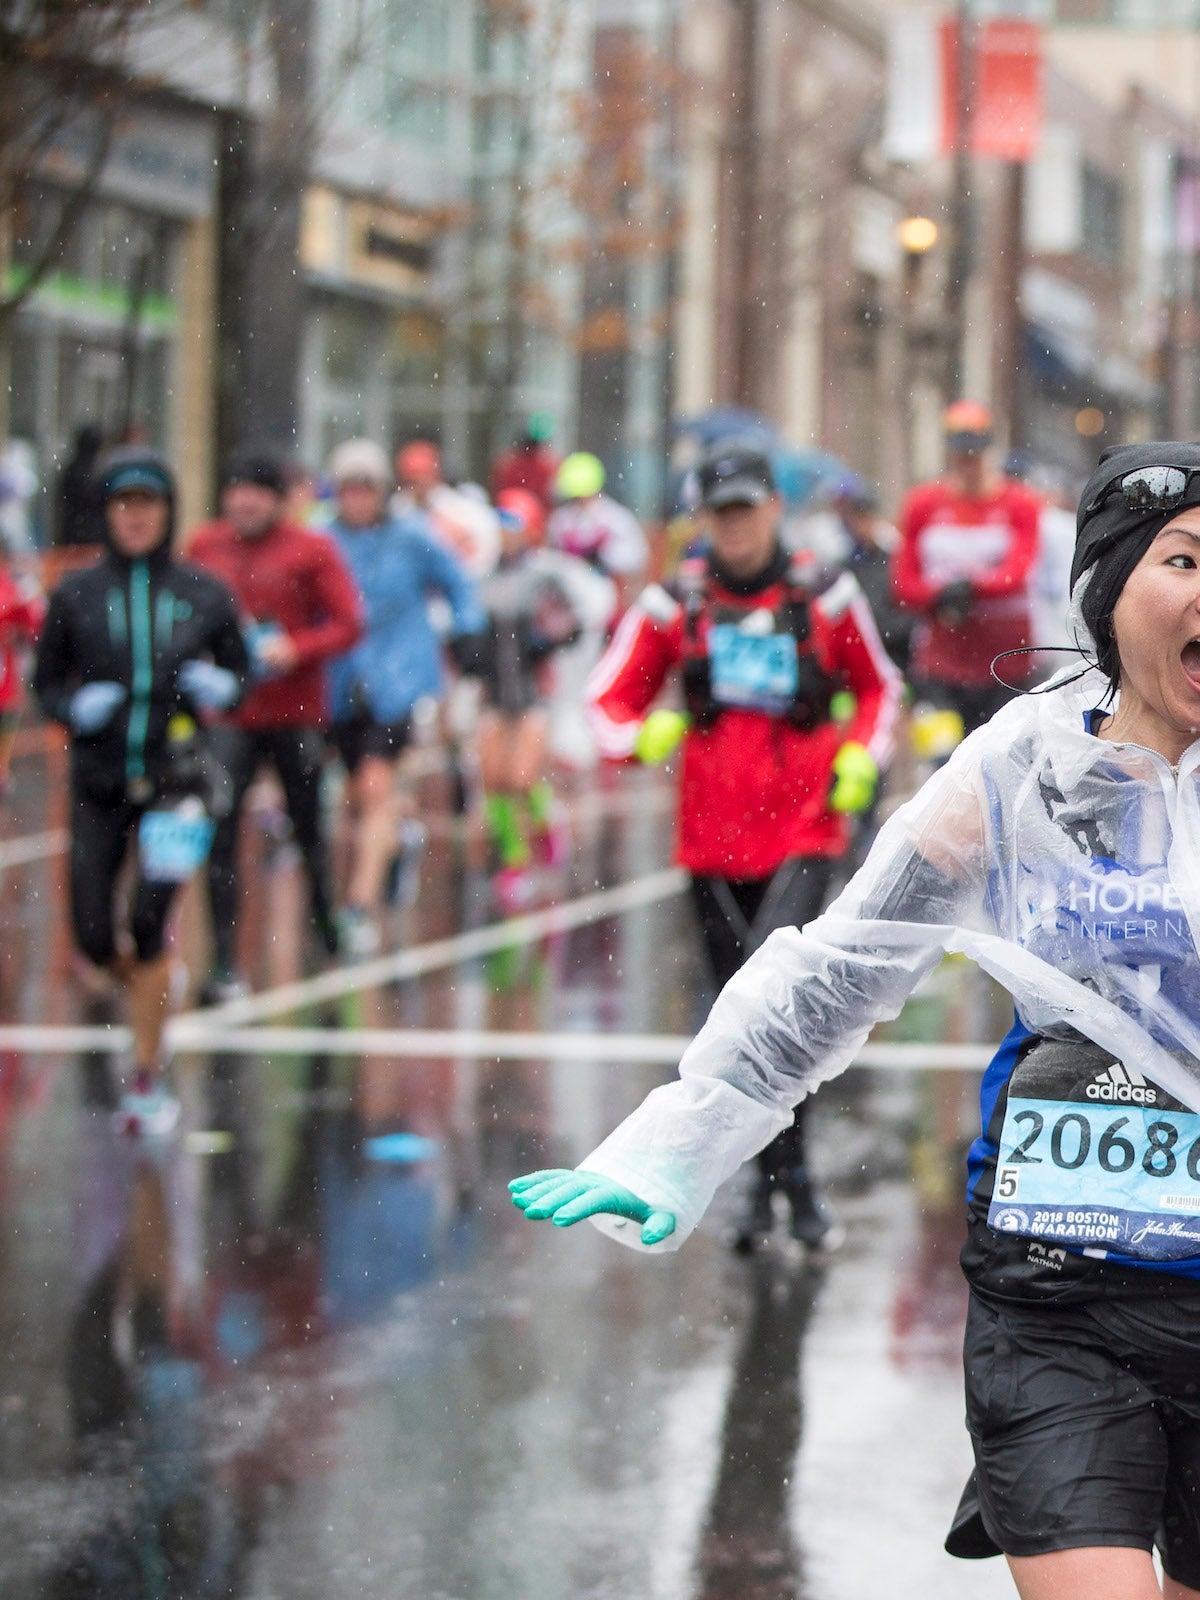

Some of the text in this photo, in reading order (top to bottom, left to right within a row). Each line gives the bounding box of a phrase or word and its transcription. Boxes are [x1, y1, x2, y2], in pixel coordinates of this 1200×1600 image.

[1068, 880, 1191, 914] HOPE
[1086, 1081, 1157, 1104] adidas
[998, 1169, 1017, 1197] 5
[1033, 1210, 1064, 1223] 2018
[1066, 1211, 1119, 1226] BOSTON
[1030, 1221, 1119, 1240] MARATHON
[1130, 1219, 1167, 1244] John
[1026, 1254, 1062, 1271] NATHAN
